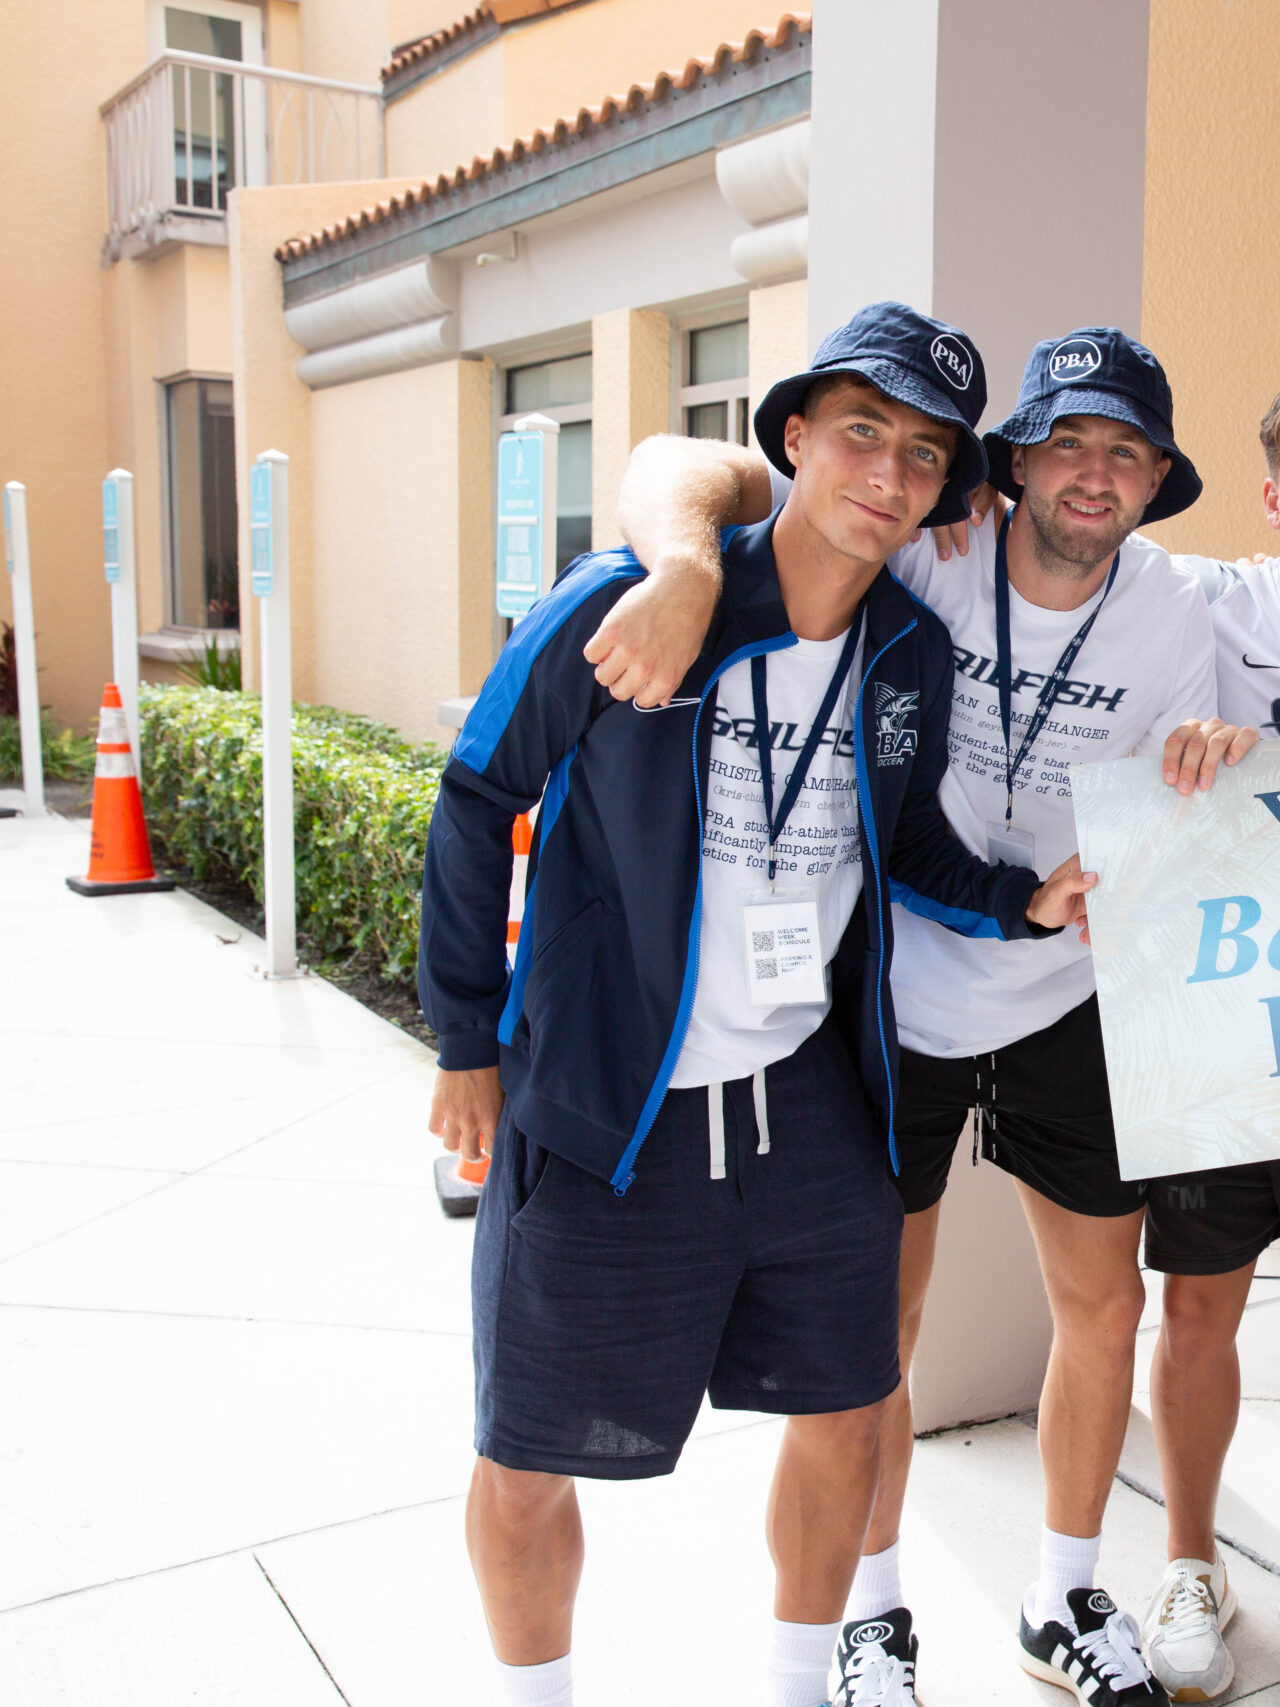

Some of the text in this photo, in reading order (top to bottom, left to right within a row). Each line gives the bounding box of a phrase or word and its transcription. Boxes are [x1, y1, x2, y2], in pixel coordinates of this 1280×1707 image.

[934, 342, 968, 384] PBA
[1053, 352, 1095, 373] PBA
[952, 645, 1130, 713] AILFISH
[877, 729, 918, 758] BA
[877, 757, 905, 768] OCCER
[1044, 757, 1070, 770] that
[966, 761, 987, 777] the
[993, 773, 1029, 790] glry
[1035, 785, 1051, 795] of
[1040, 771, 1071, 787] colle
[705, 809, 735, 830] PBA
[774, 841, 838, 858] impacting
[745, 854, 767, 870] for
[775, 858, 798, 872] the
[777, 927, 808, 935] WELCOME
